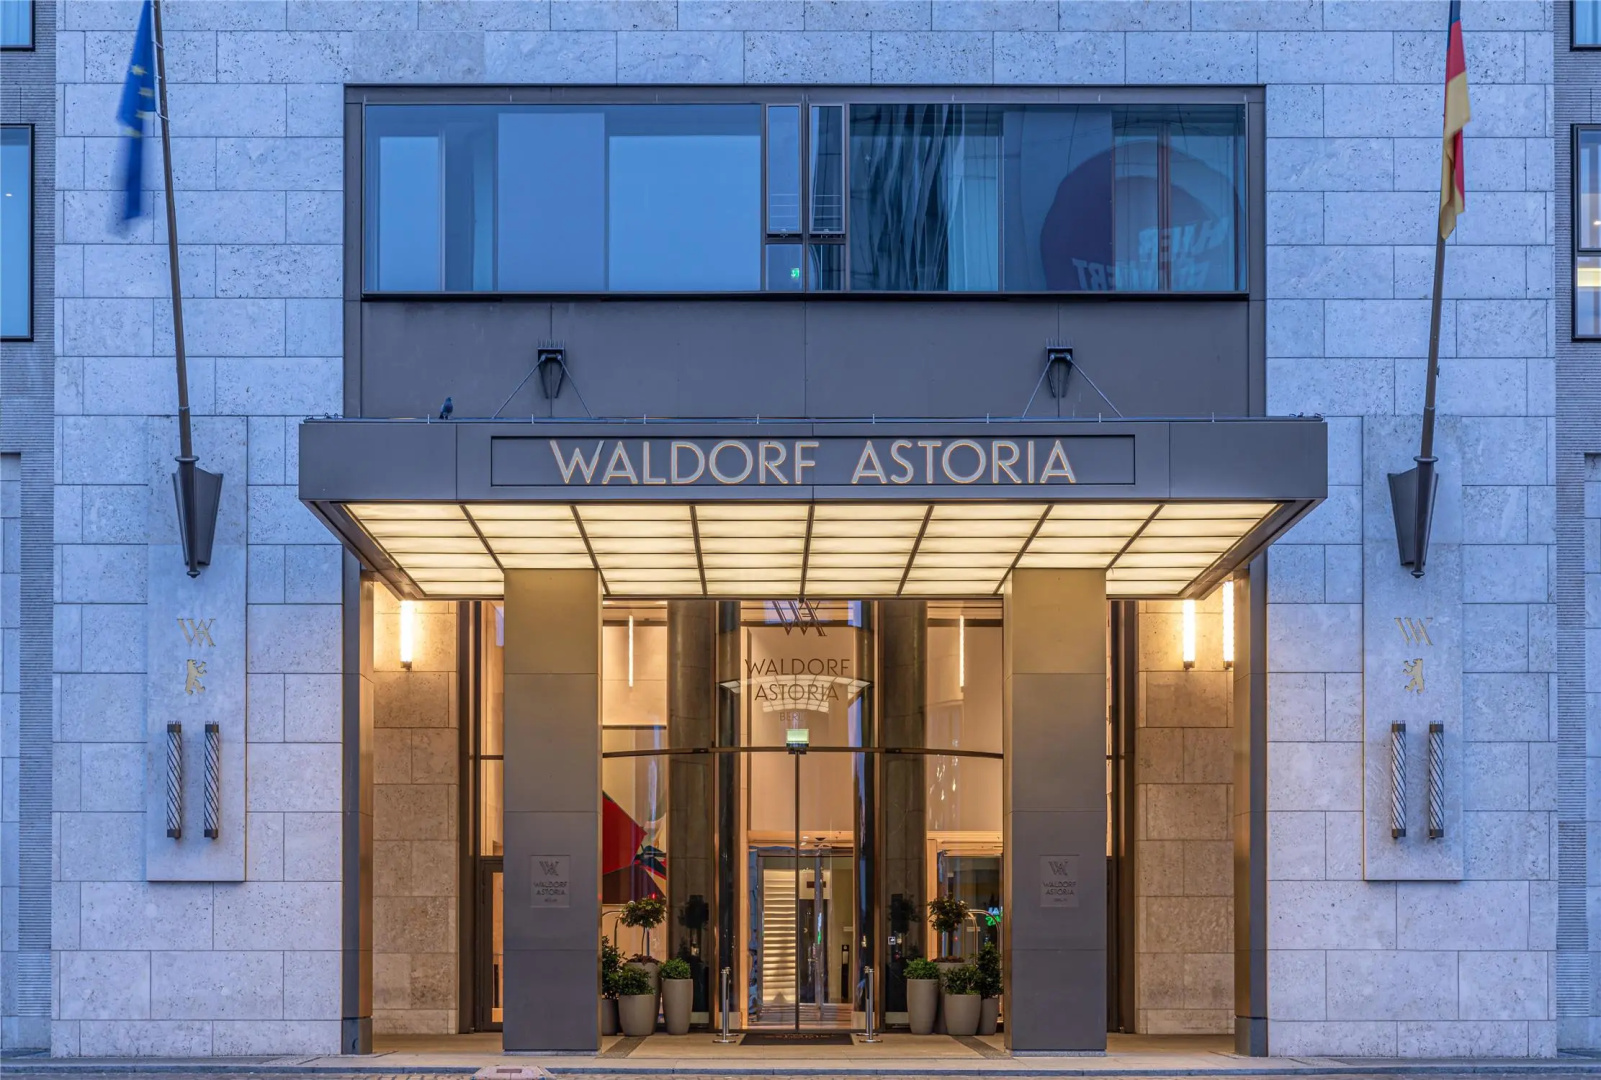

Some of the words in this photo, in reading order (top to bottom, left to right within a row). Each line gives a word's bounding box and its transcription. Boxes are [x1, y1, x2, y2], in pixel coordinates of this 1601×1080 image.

[550, 440, 820, 485] WALDORF
[851, 439, 1076, 484] ASTORIA
[744, 658, 851, 675] WALDORF
[754, 683, 840, 701] ASTORIA
[536, 888, 567, 896] ASTORIA
[1045, 888, 1075, 896] ASTORIA
